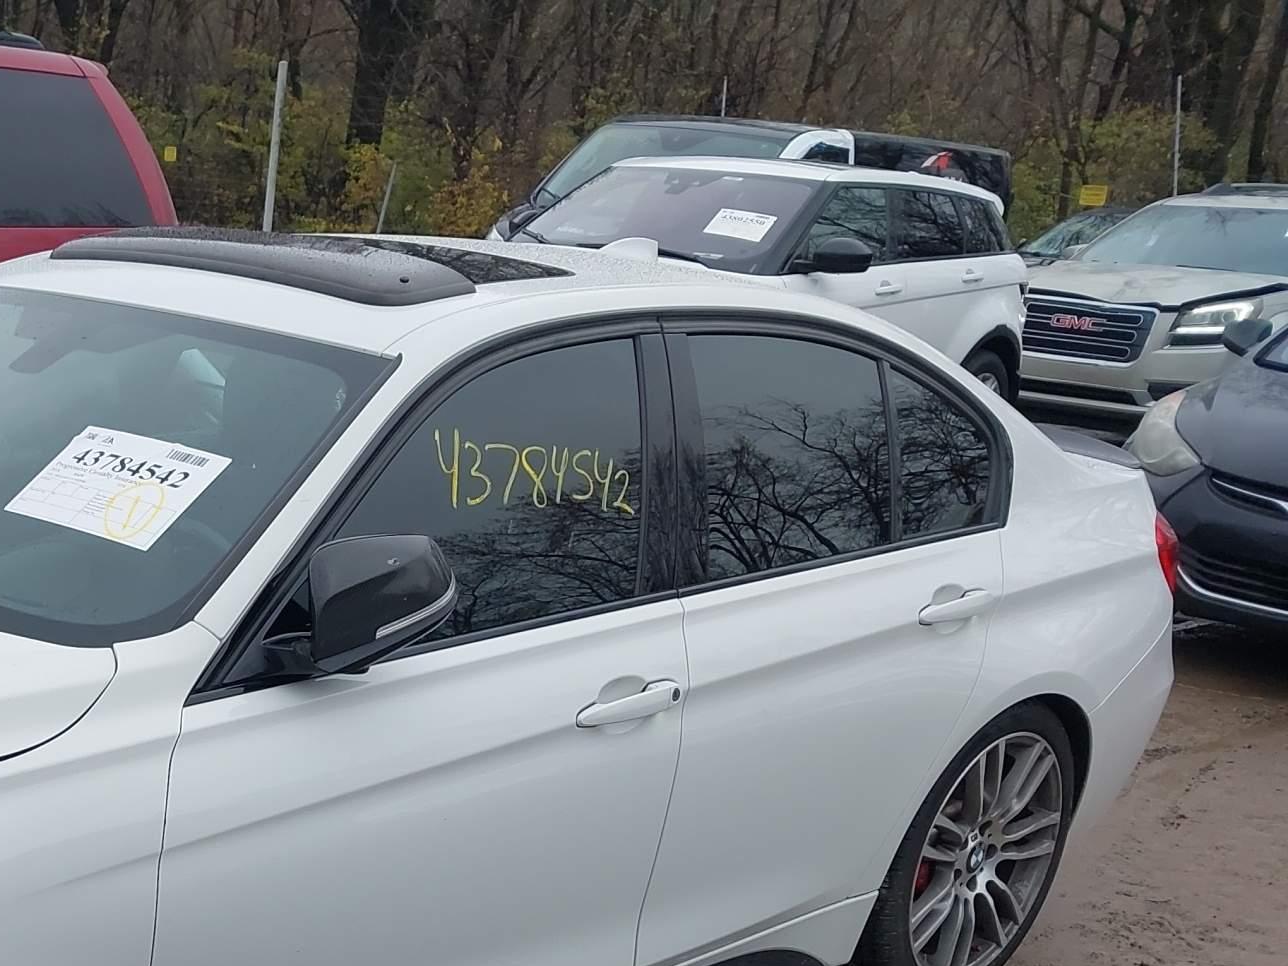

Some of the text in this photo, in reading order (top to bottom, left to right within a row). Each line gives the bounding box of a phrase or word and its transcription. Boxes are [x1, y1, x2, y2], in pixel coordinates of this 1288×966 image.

[1050, 313, 1107, 331] GMC
[72, 448, 190, 488] 43784542
[434, 428, 635, 515] 43784542
